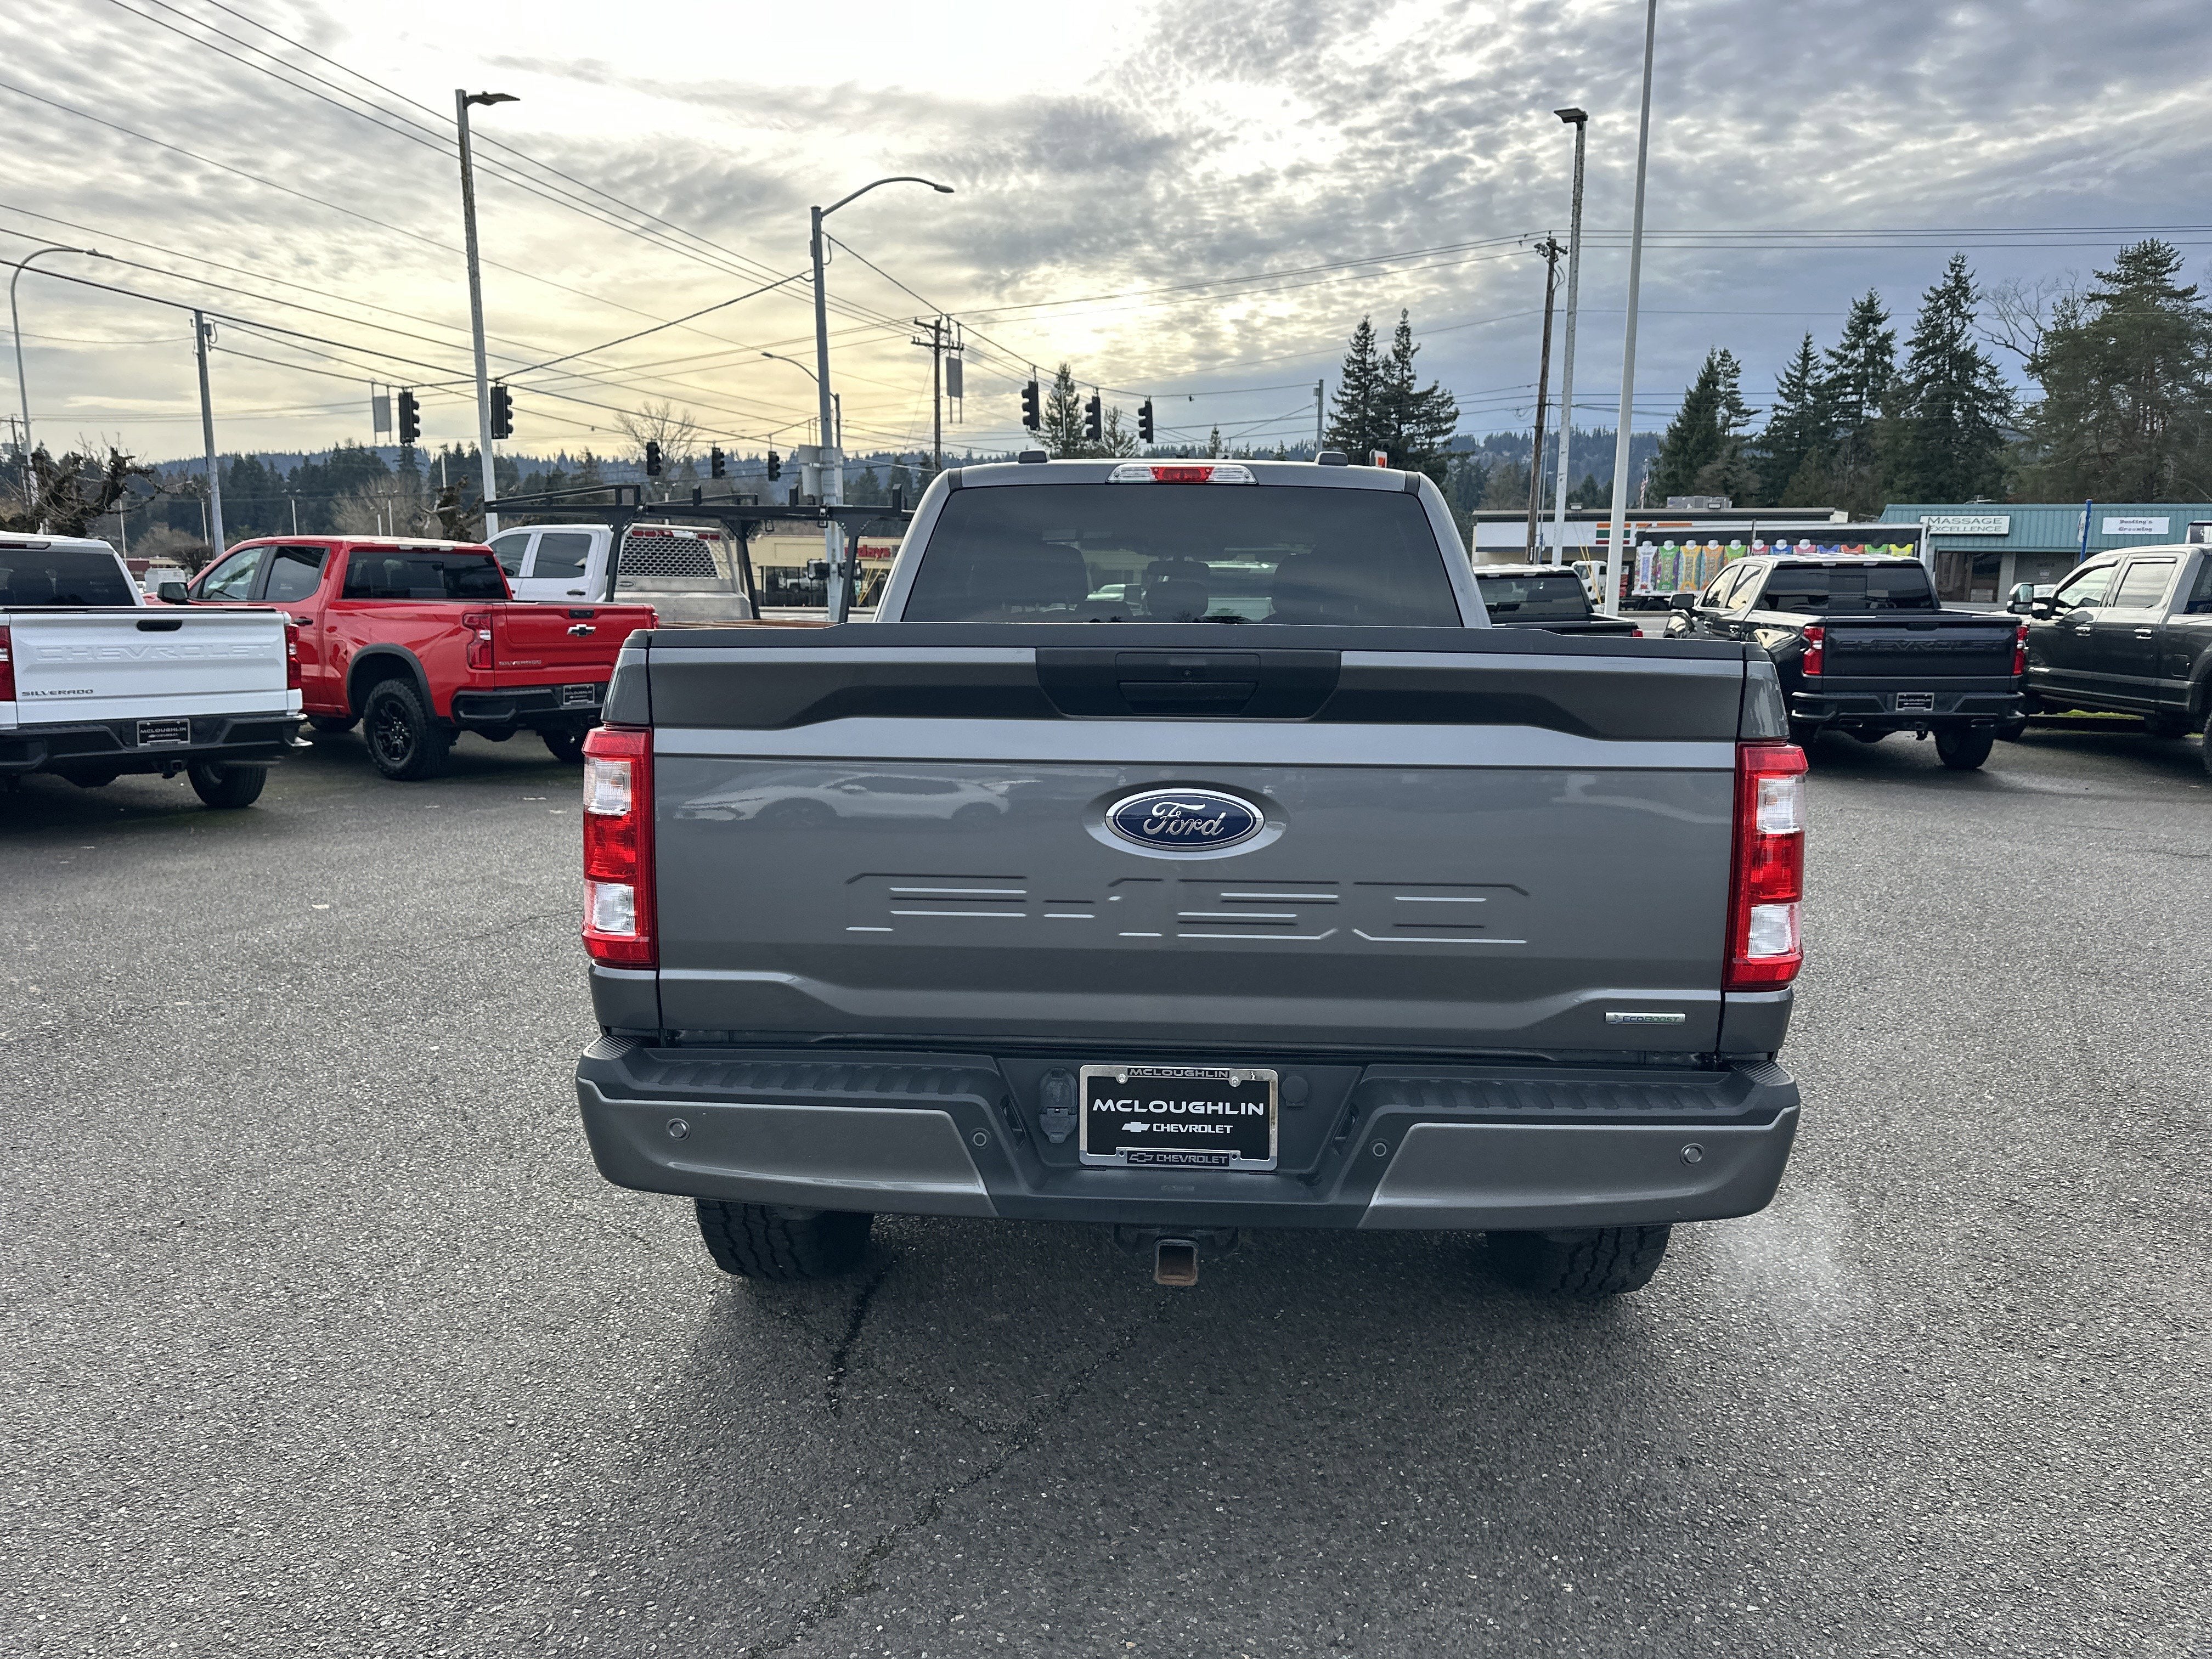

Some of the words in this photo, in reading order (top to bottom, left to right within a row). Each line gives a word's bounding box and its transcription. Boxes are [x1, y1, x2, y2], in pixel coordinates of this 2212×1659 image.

[36, 644, 272, 661] CHEVROLET
[1143, 801, 1227, 836] Ford
[845, 873, 1530, 944] F-150
[1128, 1068, 1229, 1078] MCLOUGHLIN
[1092, 1098, 1264, 1116] MCLOUGHLIN
[1153, 1123, 1233, 1133] CHEVROLET
[1156, 1153, 1228, 1164] CHEVROLET
